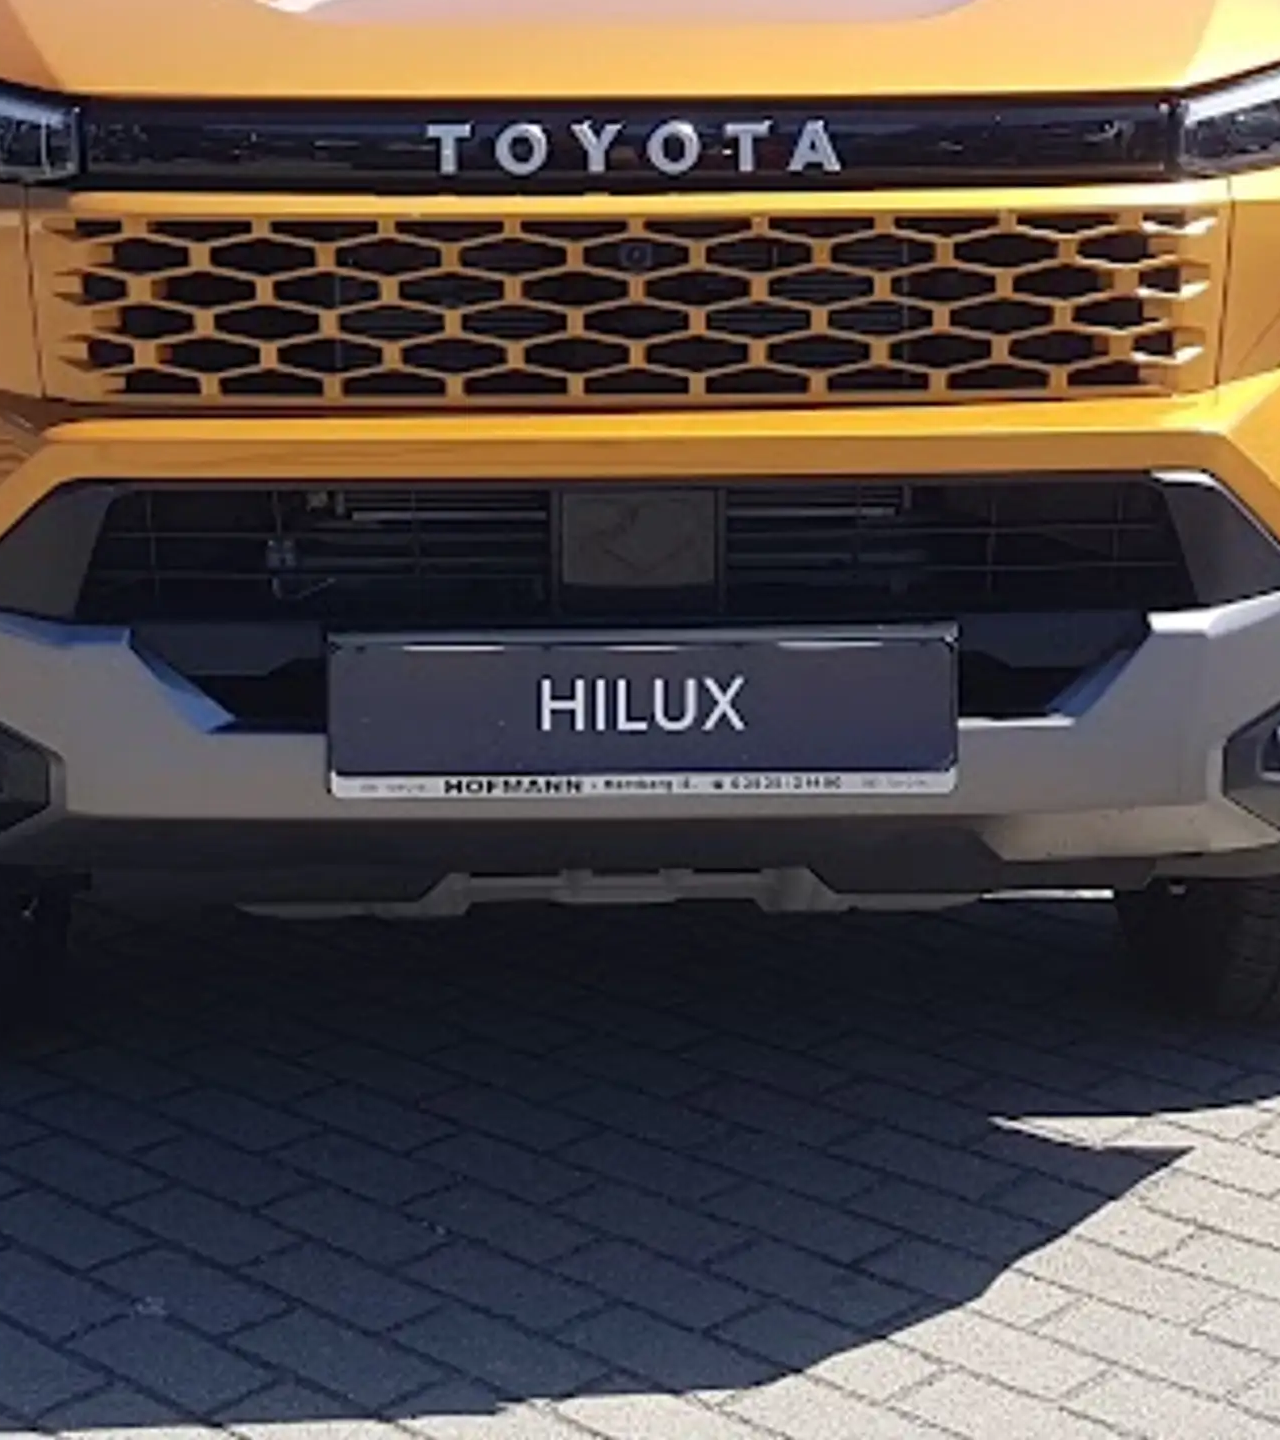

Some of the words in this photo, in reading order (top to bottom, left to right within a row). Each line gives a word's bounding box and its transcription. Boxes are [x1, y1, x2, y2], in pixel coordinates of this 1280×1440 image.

[426, 119, 842, 175] TOYOTA
[538, 675, 747, 734] HILUX
[444, 779, 583, 795] HOFMANN
